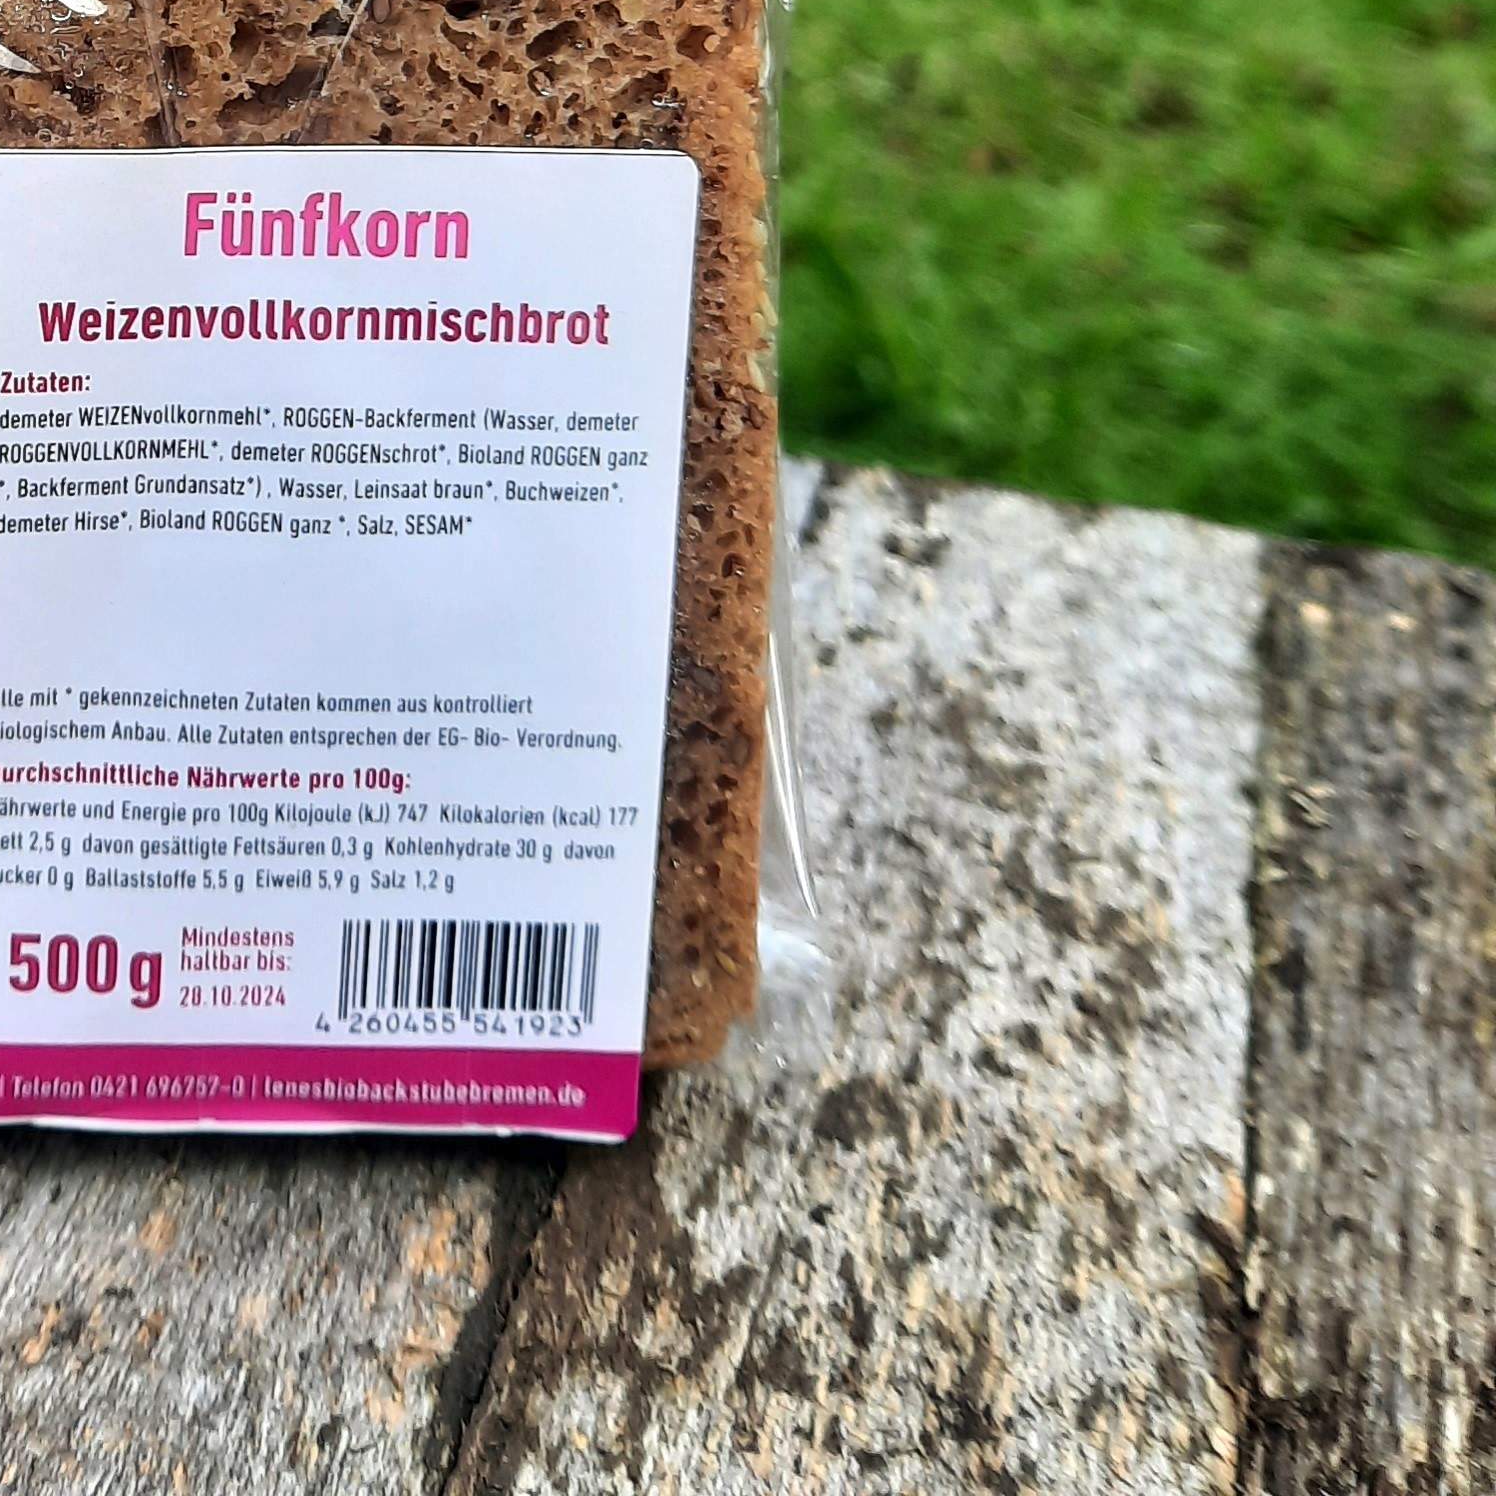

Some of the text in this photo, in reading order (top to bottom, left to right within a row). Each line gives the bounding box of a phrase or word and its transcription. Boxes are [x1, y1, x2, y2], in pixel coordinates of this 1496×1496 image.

[183, 191, 470, 258] Fünfkorn
[38, 299, 611, 345] Weizenvollkornmischbrot
[0, 370, 92, 395] Zutaten:
[0, 409, 72, 428] demeter
[283, 408, 475, 429] ROGGEN-Backferment
[484, 408, 558, 432] (Wasser,
[566, 411, 639, 431] demeter
[231, 442, 305, 462] demeter
[458, 444, 524, 465] Bioland
[531, 446, 601, 466] ROGGEN
[608, 450, 648, 470] ganz
[17, 477, 128, 497] Backferment
[279, 478, 347, 500] Wasser,
[355, 479, 427, 498] Leinsaat
[139, 509, 205, 529] Bioland
[212, 511, 282, 532] ROGGEN
[290, 517, 331, 538] ganz
[358, 515, 398, 536] Salz,
[30, 688, 58, 706] mit
[79, 687, 238, 711] gekennzeichneten
[245, 692, 310, 712] Zutaten
[316, 693, 391, 712] kommen
[397, 697, 427, 713] aus
[433, 695, 533, 714] kontrolliert
[111, 721, 171, 742] Anbau.
[178, 723, 212, 742] Alle
[218, 724, 283, 744] Zutaten
[290, 727, 396, 747] entsprechen
[403, 728, 431, 745] der
[439, 728, 467, 746] EG-
[474, 728, 508, 746] Bio-
[517, 729, 622, 751] Verordnung.
[187, 765, 300, 788] Nährwerte
[309, 772, 344, 793] pro
[354, 767, 411, 793] 100g:
[83, 800, 114, 819] und
[122, 801, 186, 825] Energie
[193, 807, 220, 825] pro
[229, 803, 268, 825] 100g
[275, 803, 351, 826] Kilojoule
[358, 802, 390, 825] (kJ)
[398, 804, 427, 822] 747
[440, 804, 544, 825] Kilokalorien
[553, 806, 601, 828] (kcal)
[608, 806, 639, 826] 177
[29, 831, 54, 853] 2,5
[61, 836, 71, 855] g
[83, 835, 133, 853] davon
[140, 836, 227, 859] gesättigte
[233, 836, 324, 856] Fettsäuren
[331, 836, 356, 857] 0,3
[363, 841, 373, 860] g
[385, 836, 510, 859] Kohlenhydrate
[516, 839, 536, 857] 30
[543, 844, 552, 862] g
[564, 839, 615, 859] davon
[47, 867, 57, 885] 0
[64, 871, 74, 890] g
[85, 866, 196, 889] Ballaststoffe
[203, 870, 228, 890] 5,5
[234, 873, 244, 892] g
[256, 870, 311, 889] Eiweiß
[318, 870, 343, 890] 5,9
[350, 874, 359, 893] g
[371, 870, 405, 889] Salz
[415, 871, 437, 890] 1,2
[445, 874, 454, 893] g
[181, 927, 294, 947] Mindestens
[180, 949, 292, 972] haltbar bis:
[179, 986, 286, 1006] 28.10.2024
[315, 1011, 584, 1037] 4 260455 541923
[13, 1075, 84, 1100] Telefon
[90, 1075, 138, 1098] 0421
